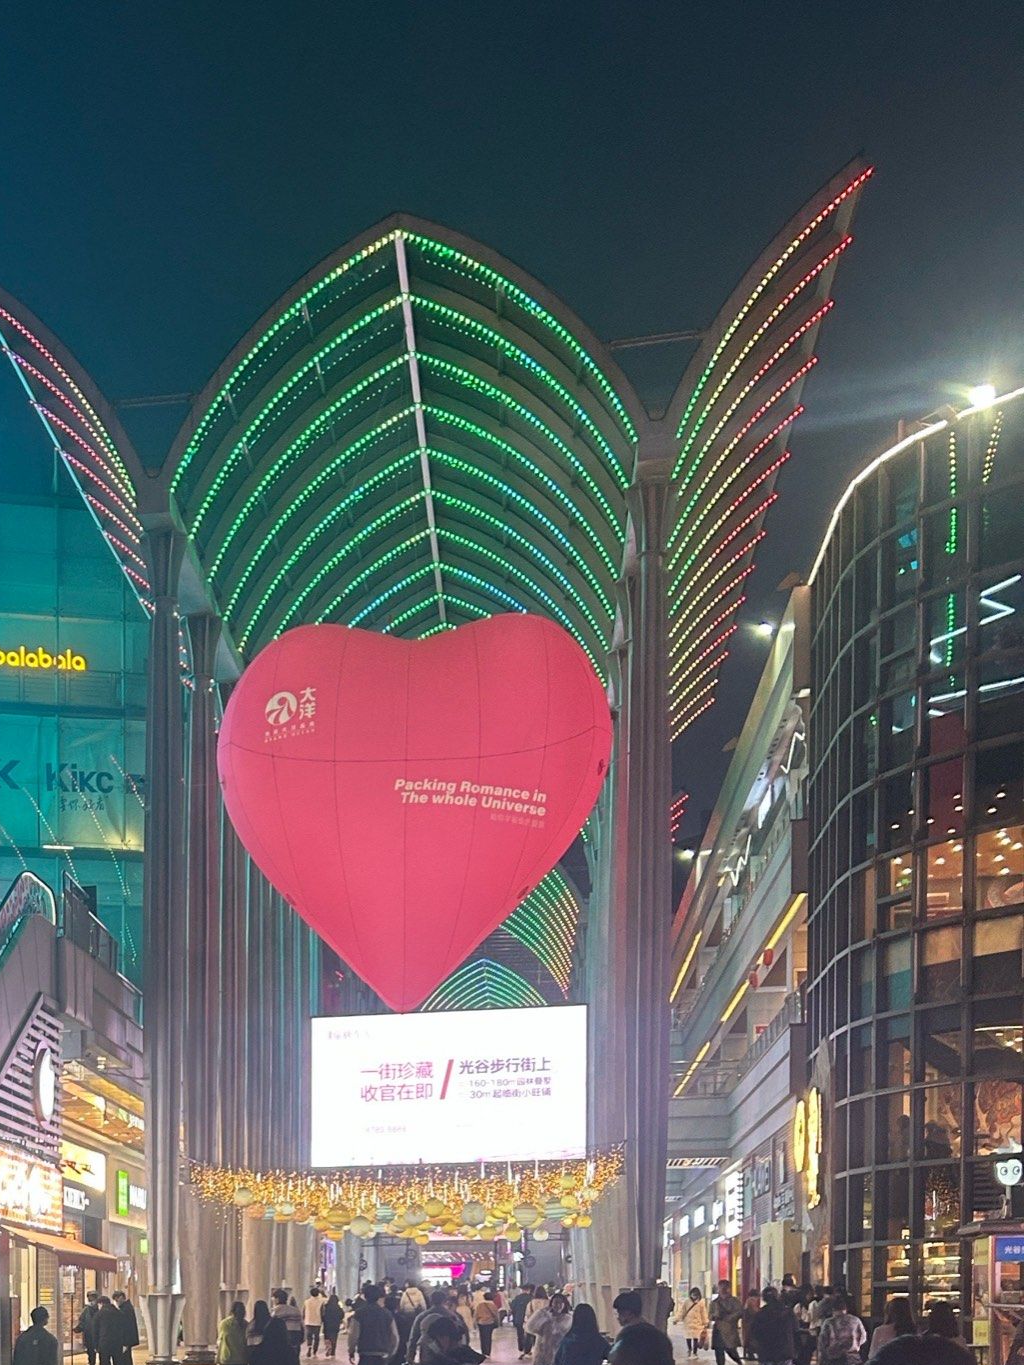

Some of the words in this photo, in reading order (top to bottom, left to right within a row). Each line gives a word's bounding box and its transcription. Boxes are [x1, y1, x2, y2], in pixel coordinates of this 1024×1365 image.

[299, 687, 316, 720] 大洋
[394, 778, 457, 793] Packing
[460, 781, 530, 800] Romance
[533, 789, 547, 802] in
[401, 791, 428, 804] The
[432, 791, 478, 806] whole
[481, 796, 546, 816] Universe
[360, 1061, 434, 1080] 一街珍藏
[458, 1057, 552, 1075] 光谷步行街上
[360, 1083, 434, 1102] 收官在即
[1004, 1245, 1024, 1255] 光谷
